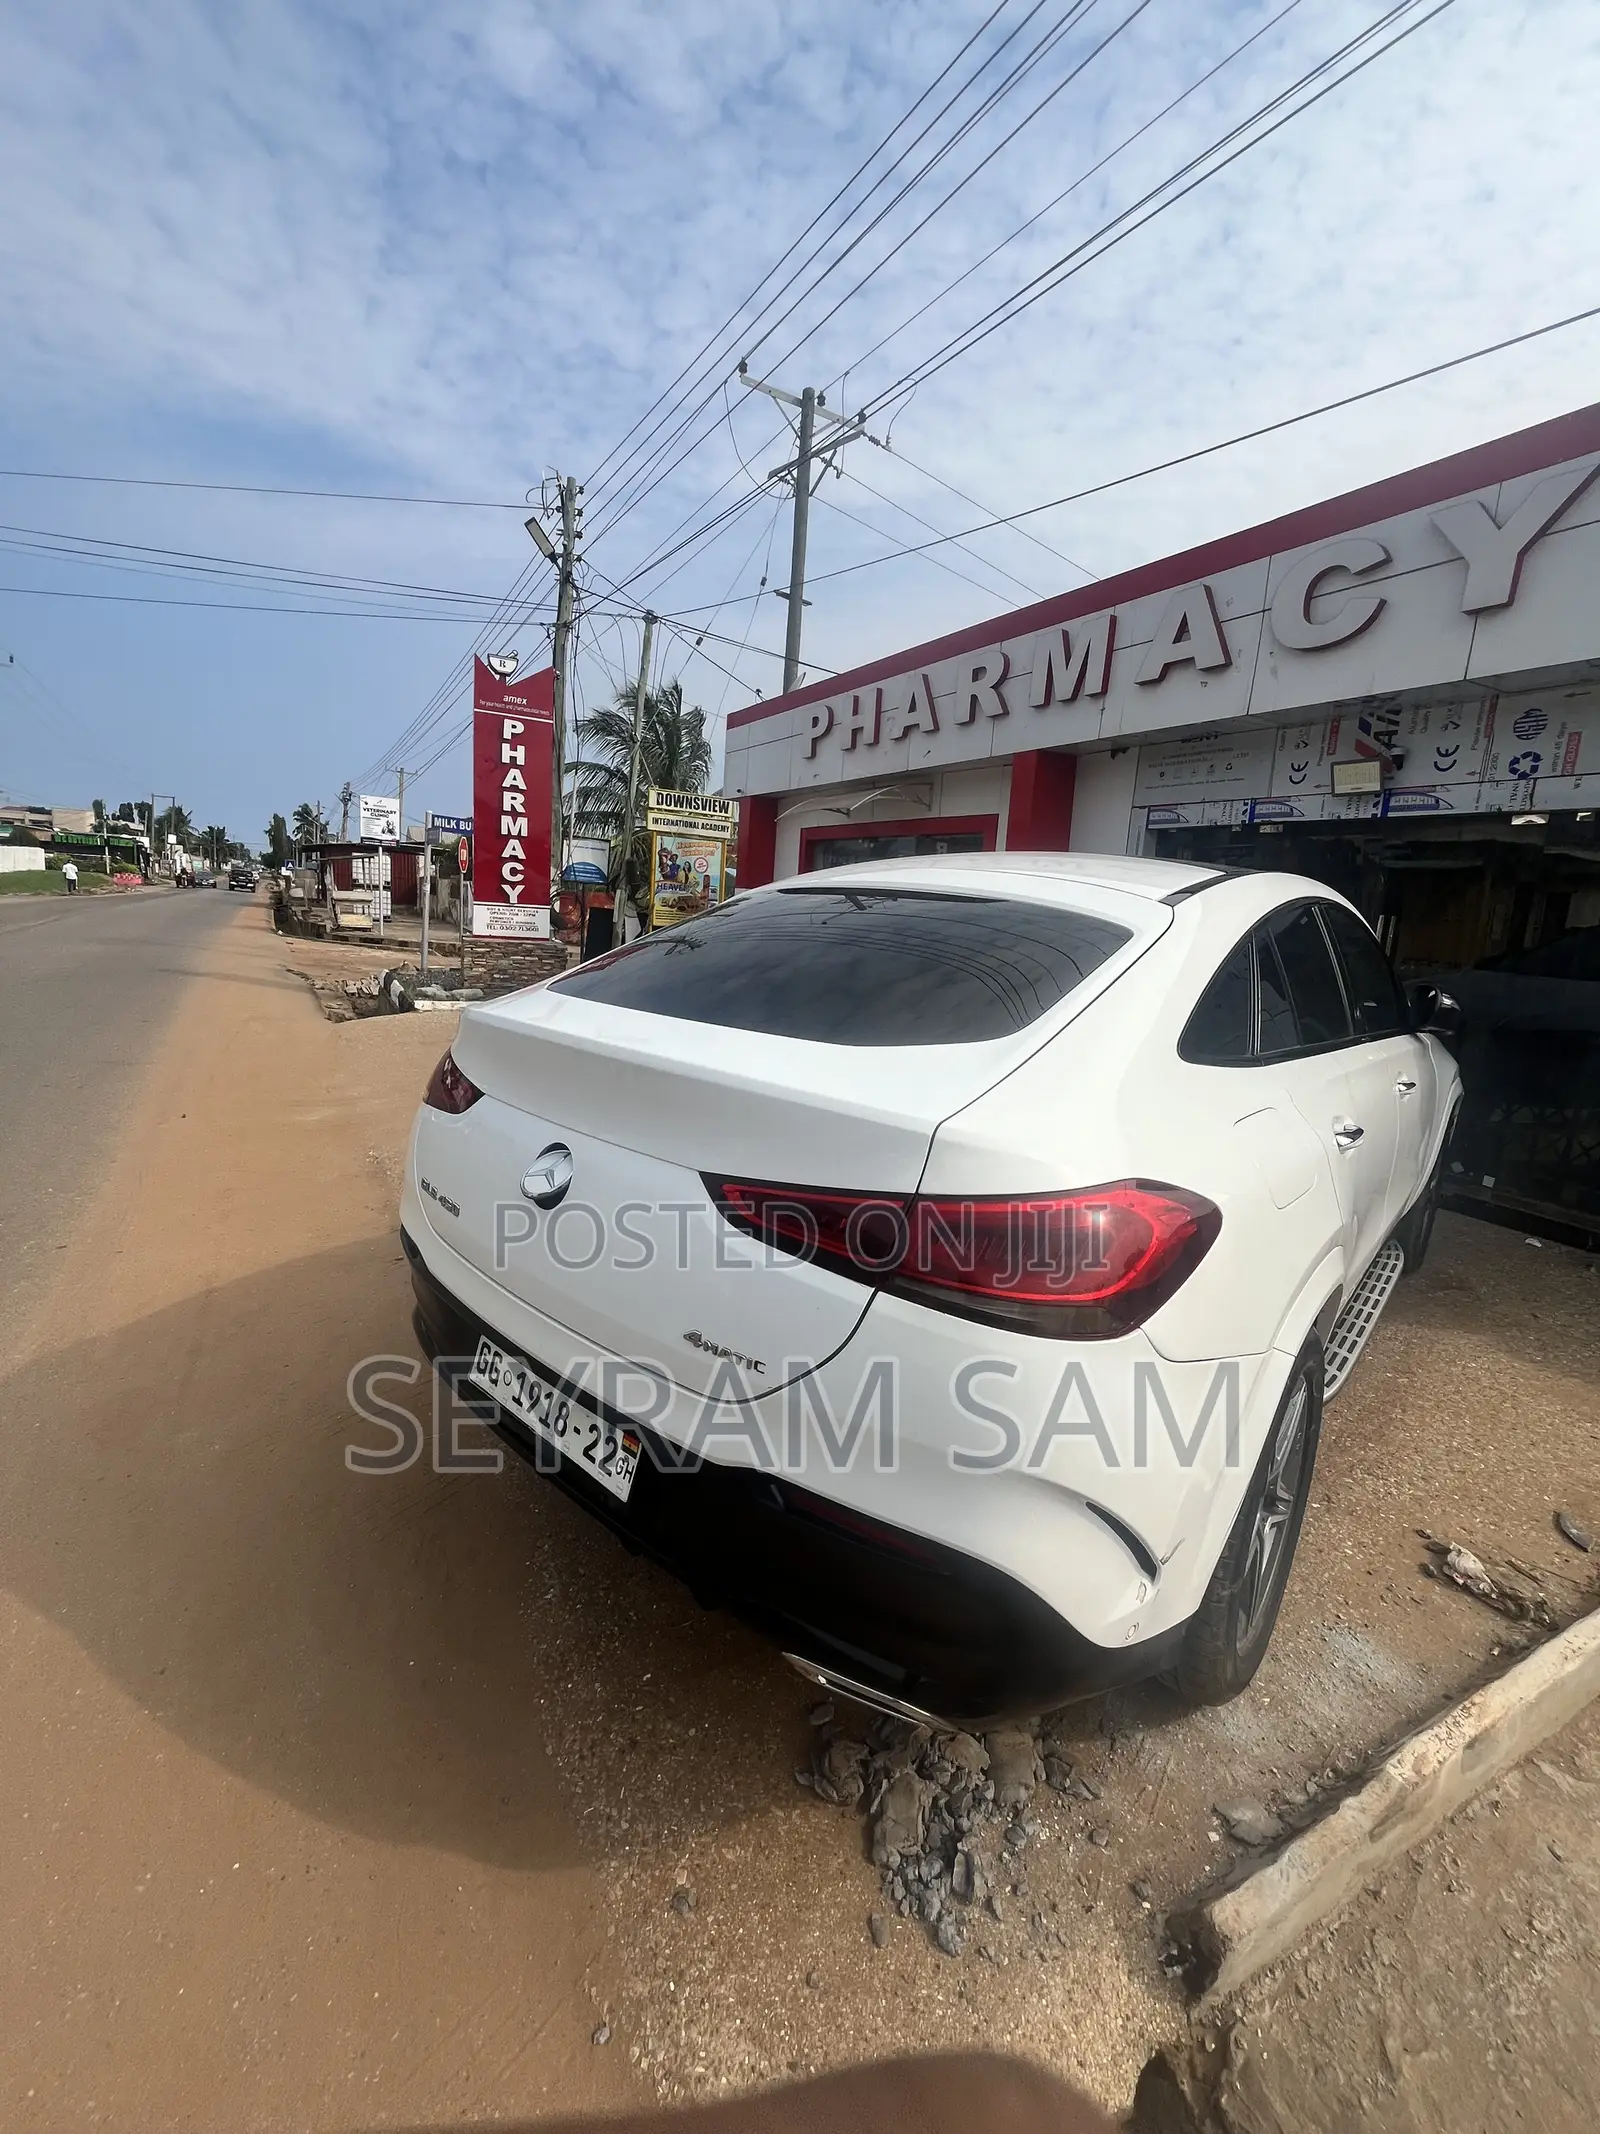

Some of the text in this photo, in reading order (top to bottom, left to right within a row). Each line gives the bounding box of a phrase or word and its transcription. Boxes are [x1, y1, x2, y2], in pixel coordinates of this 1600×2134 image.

[801, 464, 1600, 759] PHARMACY
[503, 694, 528, 706] amex
[362, 807, 397, 815] VETERINARY
[501, 718, 529, 904] PHARMACY
[656, 792, 730, 814] DOWNSVIEW
[434, 817, 473, 831] MILK BU
[652, 817, 729, 833] INTERNATIONAL ACADEMY
[683, 1328, 767, 1375] 4MATIC
